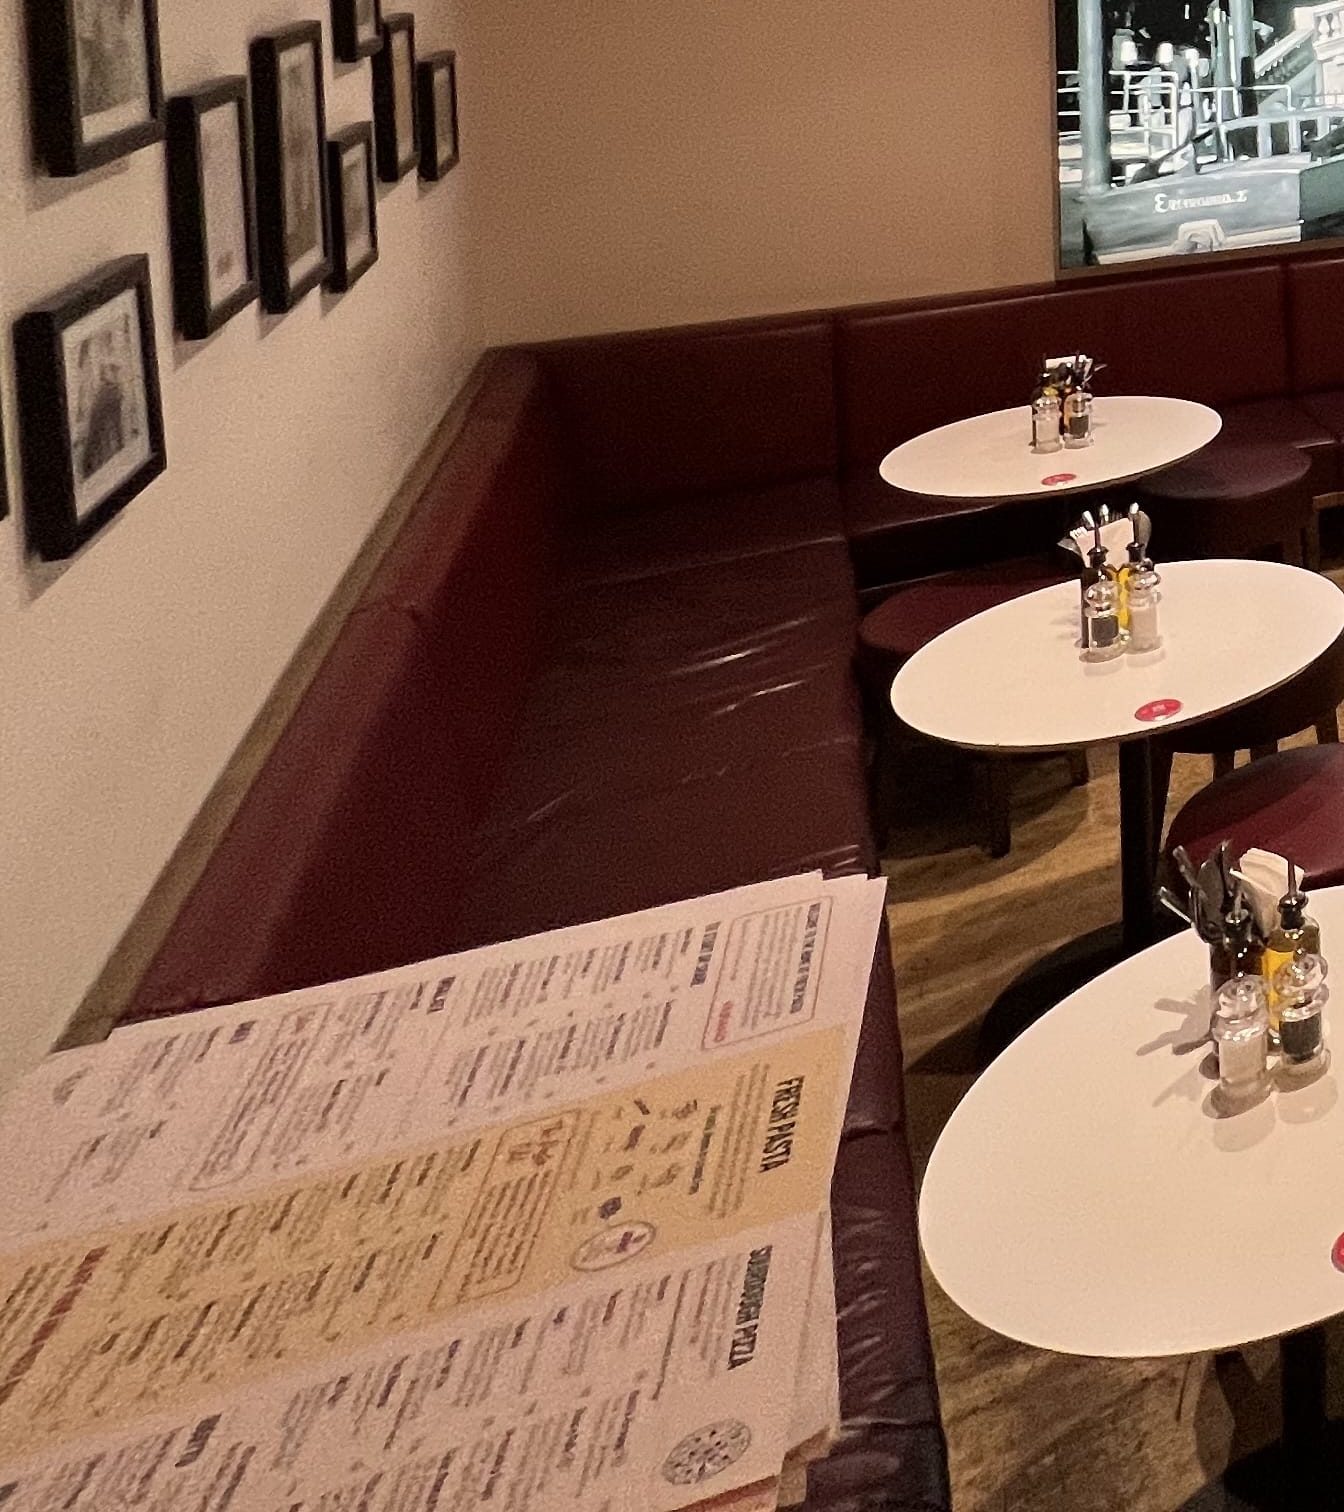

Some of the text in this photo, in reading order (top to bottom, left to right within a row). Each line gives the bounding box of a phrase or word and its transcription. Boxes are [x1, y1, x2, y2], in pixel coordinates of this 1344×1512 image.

[758, 1074, 805, 1173] FRESH PASTA
[727, 1323, 759, 1370] PIZZA
